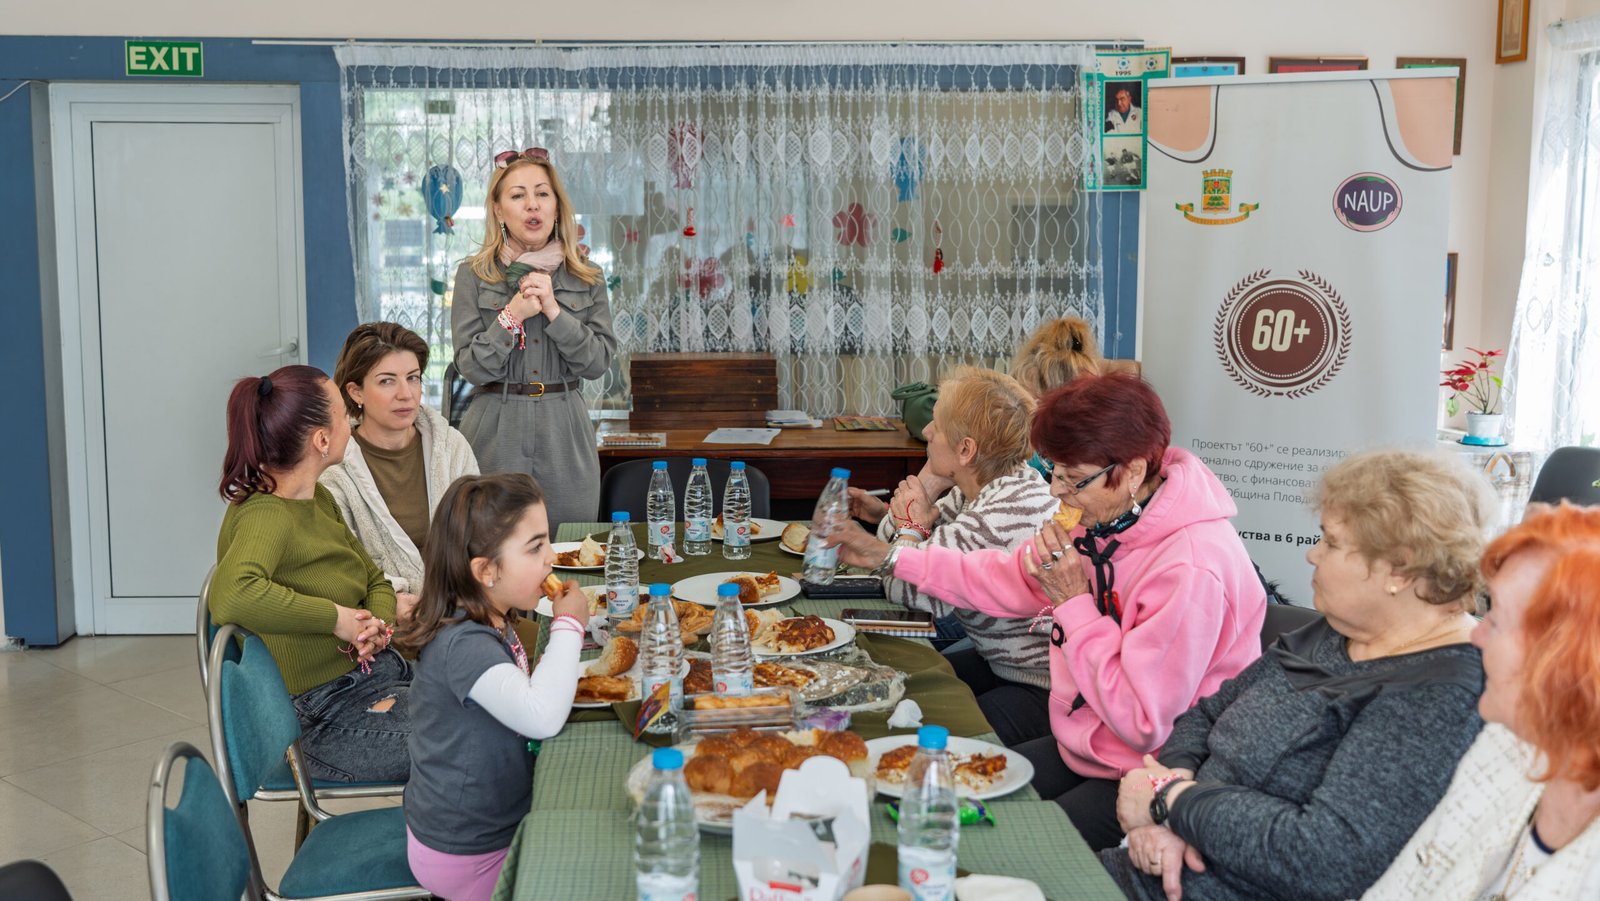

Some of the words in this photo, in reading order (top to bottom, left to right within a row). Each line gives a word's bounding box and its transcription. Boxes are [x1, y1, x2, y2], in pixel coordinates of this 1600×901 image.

[129, 46, 199, 71] EXIT
[1344, 189, 1394, 212] NAUP
[1251, 308, 1311, 352] 60+
[1192, 438, 1242, 453] Проектът
[1246, 441, 1274, 453] "60+"
[1276, 445, 1289, 455] се
[1199, 456, 1242, 467] онално
[1244, 459, 1304, 472] сдружение
[1307, 463, 1318, 473] за
[1241, 475, 1248, 483] с
[1250, 474, 1319, 488] финансоват
[1274, 534, 1283, 543] в
[1285, 533, 1294, 543] 6
[1296, 535, 1321, 546] рай
